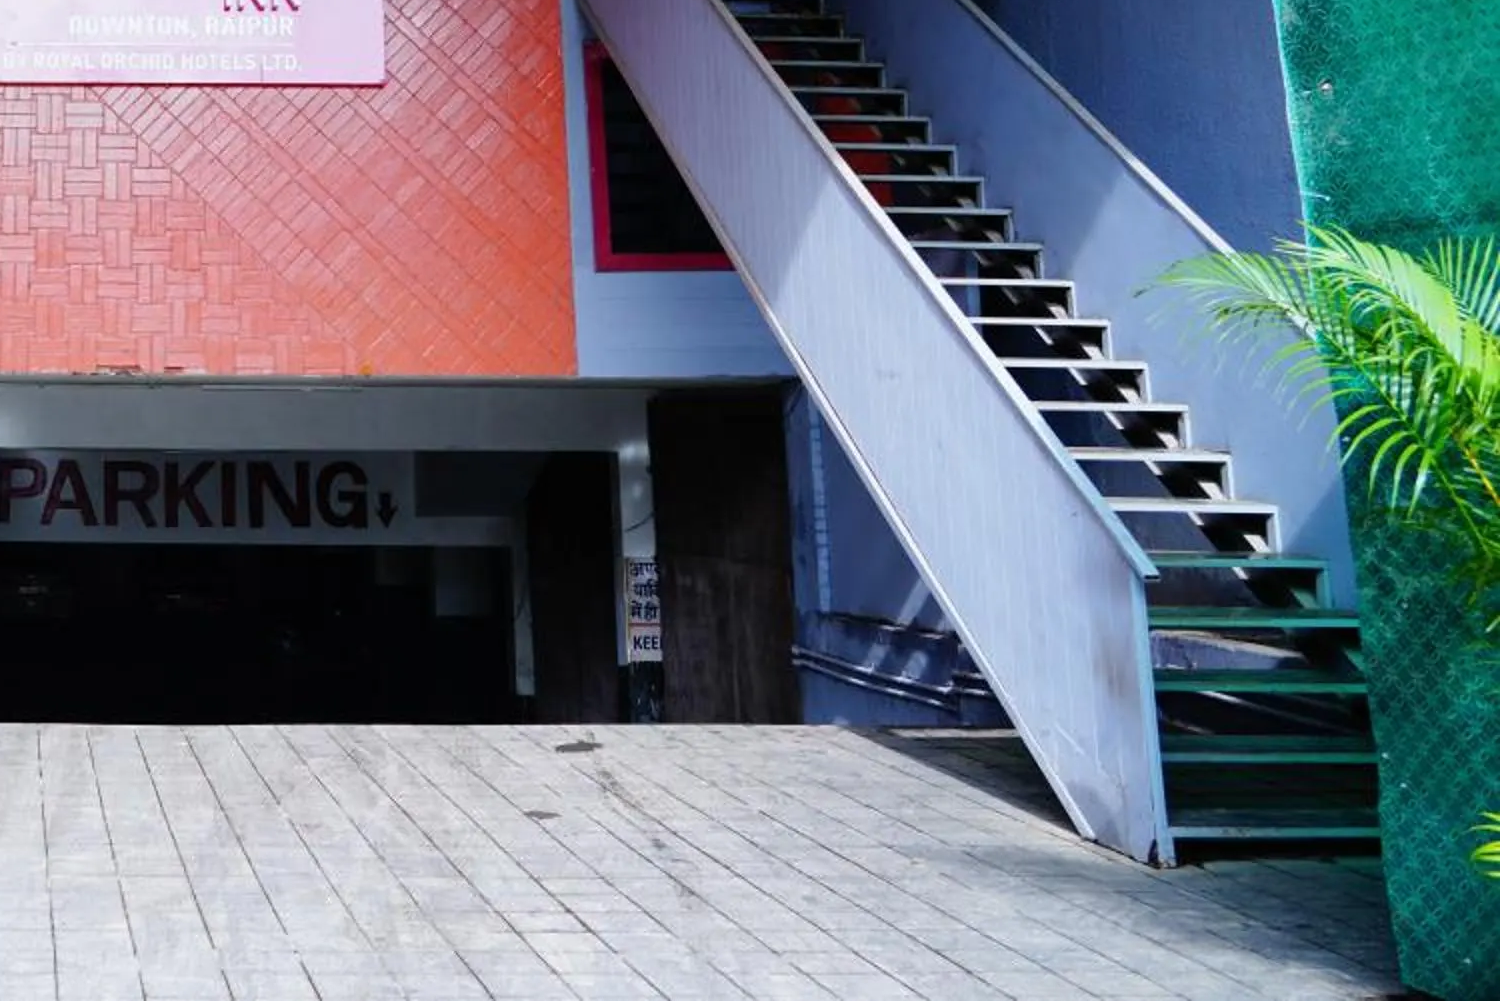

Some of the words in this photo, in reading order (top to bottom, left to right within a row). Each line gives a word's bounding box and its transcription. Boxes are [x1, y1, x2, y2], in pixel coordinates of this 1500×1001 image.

[204, 15, 294, 36] RAIPUR
[33, 52, 95, 70] ROYAL
[101, 52, 175, 71] ORCHID
[181, 53, 257, 71] HOTELS
[261, 53, 303, 71] LTD.
